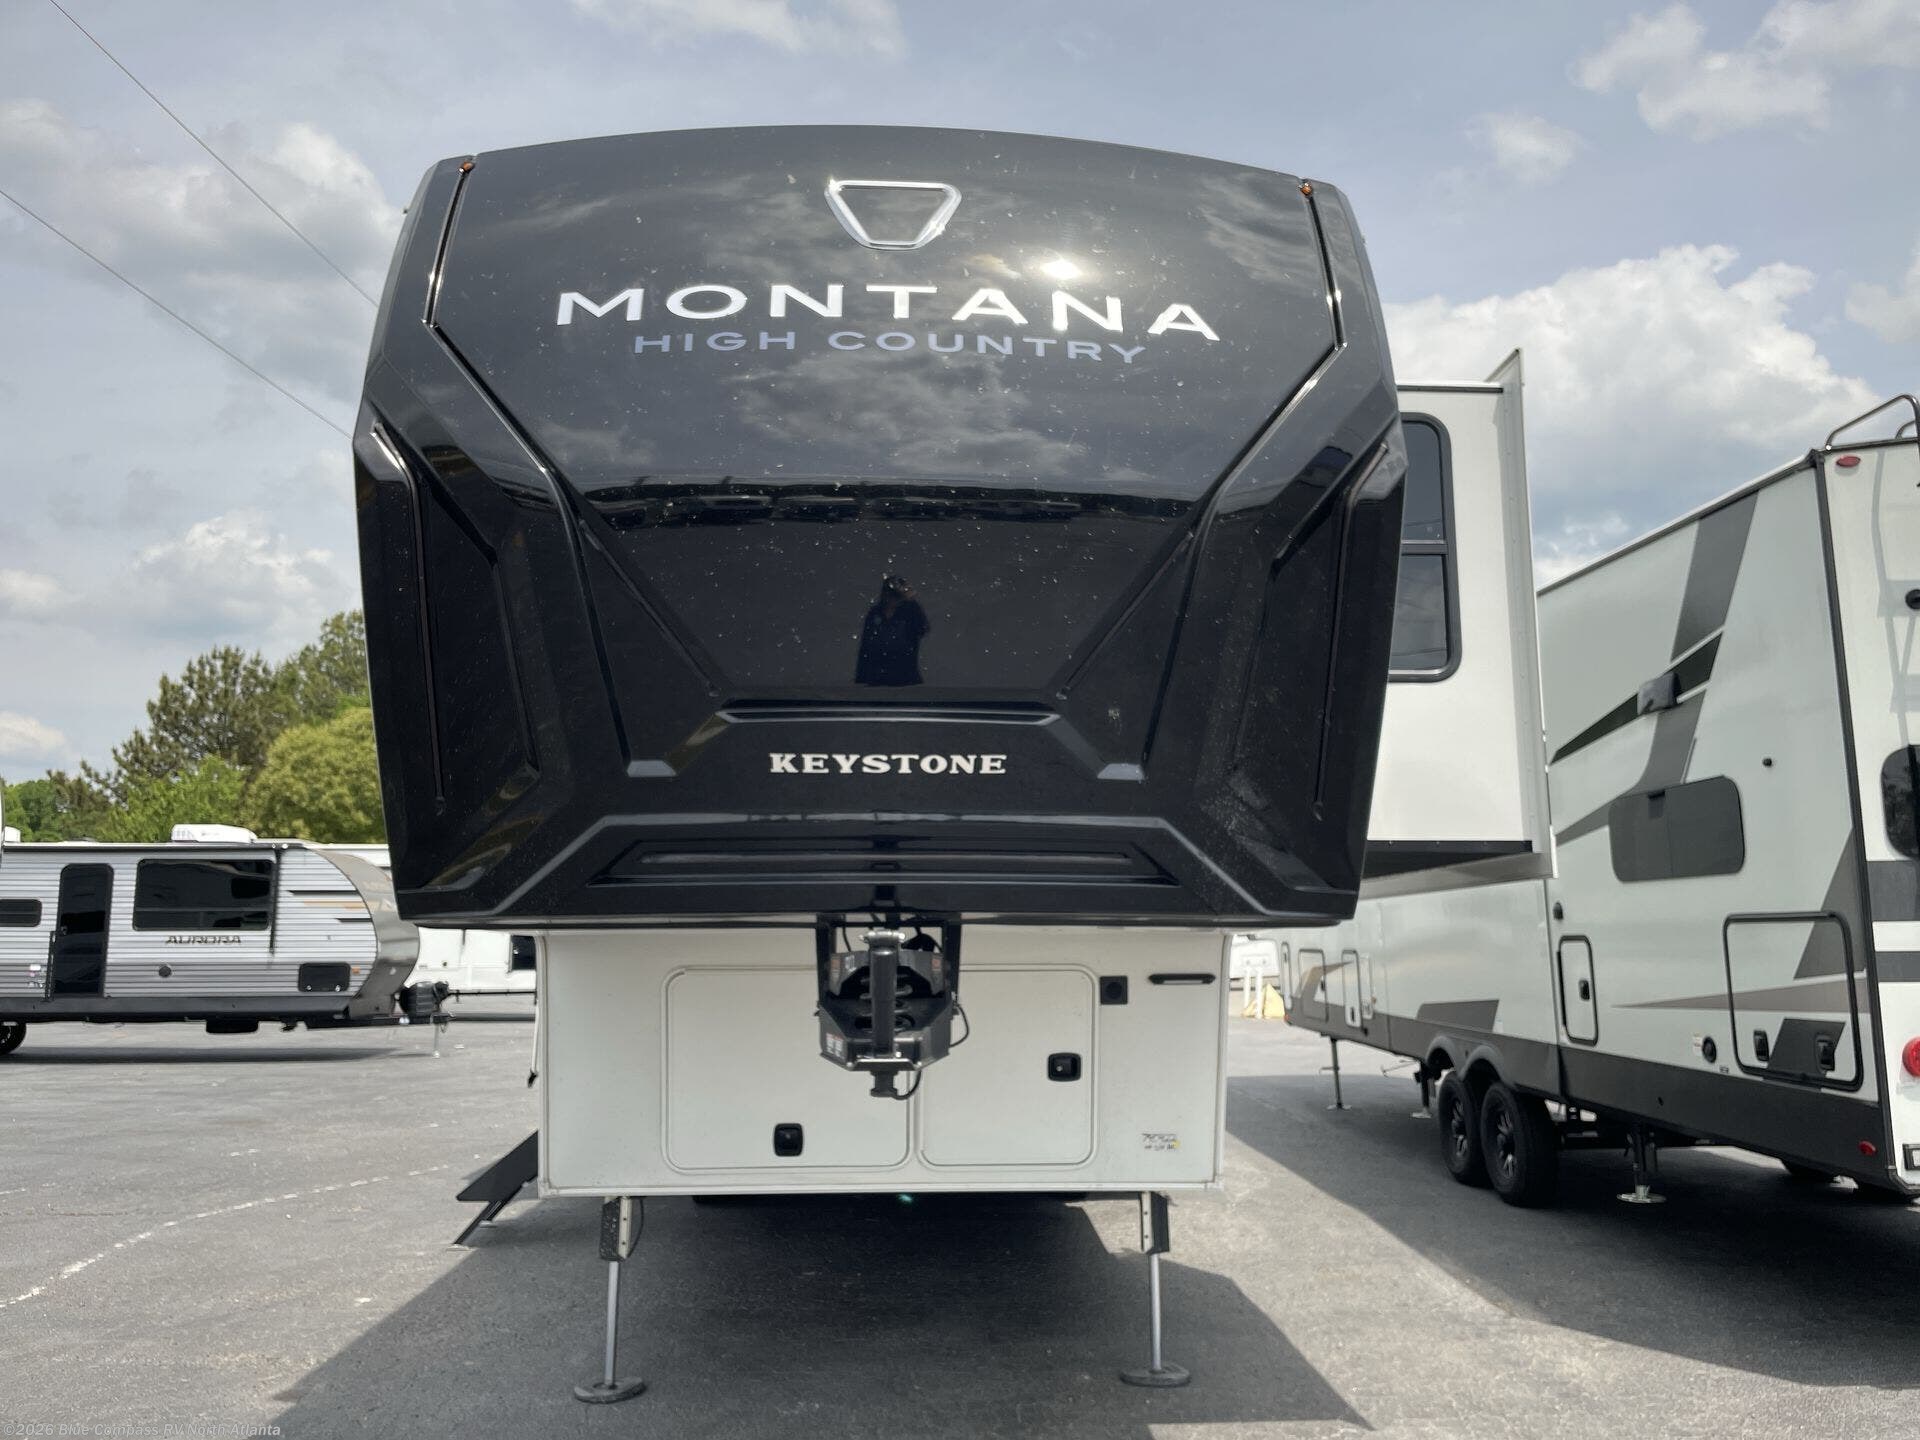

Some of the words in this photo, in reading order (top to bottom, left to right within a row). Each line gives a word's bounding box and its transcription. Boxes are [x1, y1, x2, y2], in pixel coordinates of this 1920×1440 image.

[557, 284, 1220, 341] MONTANA
[634, 331, 795, 353] HIGH
[827, 331, 1146, 364] COUNTRY
[769, 752, 1008, 775] KEYSTONE
[165, 935, 241, 944] AURORA
